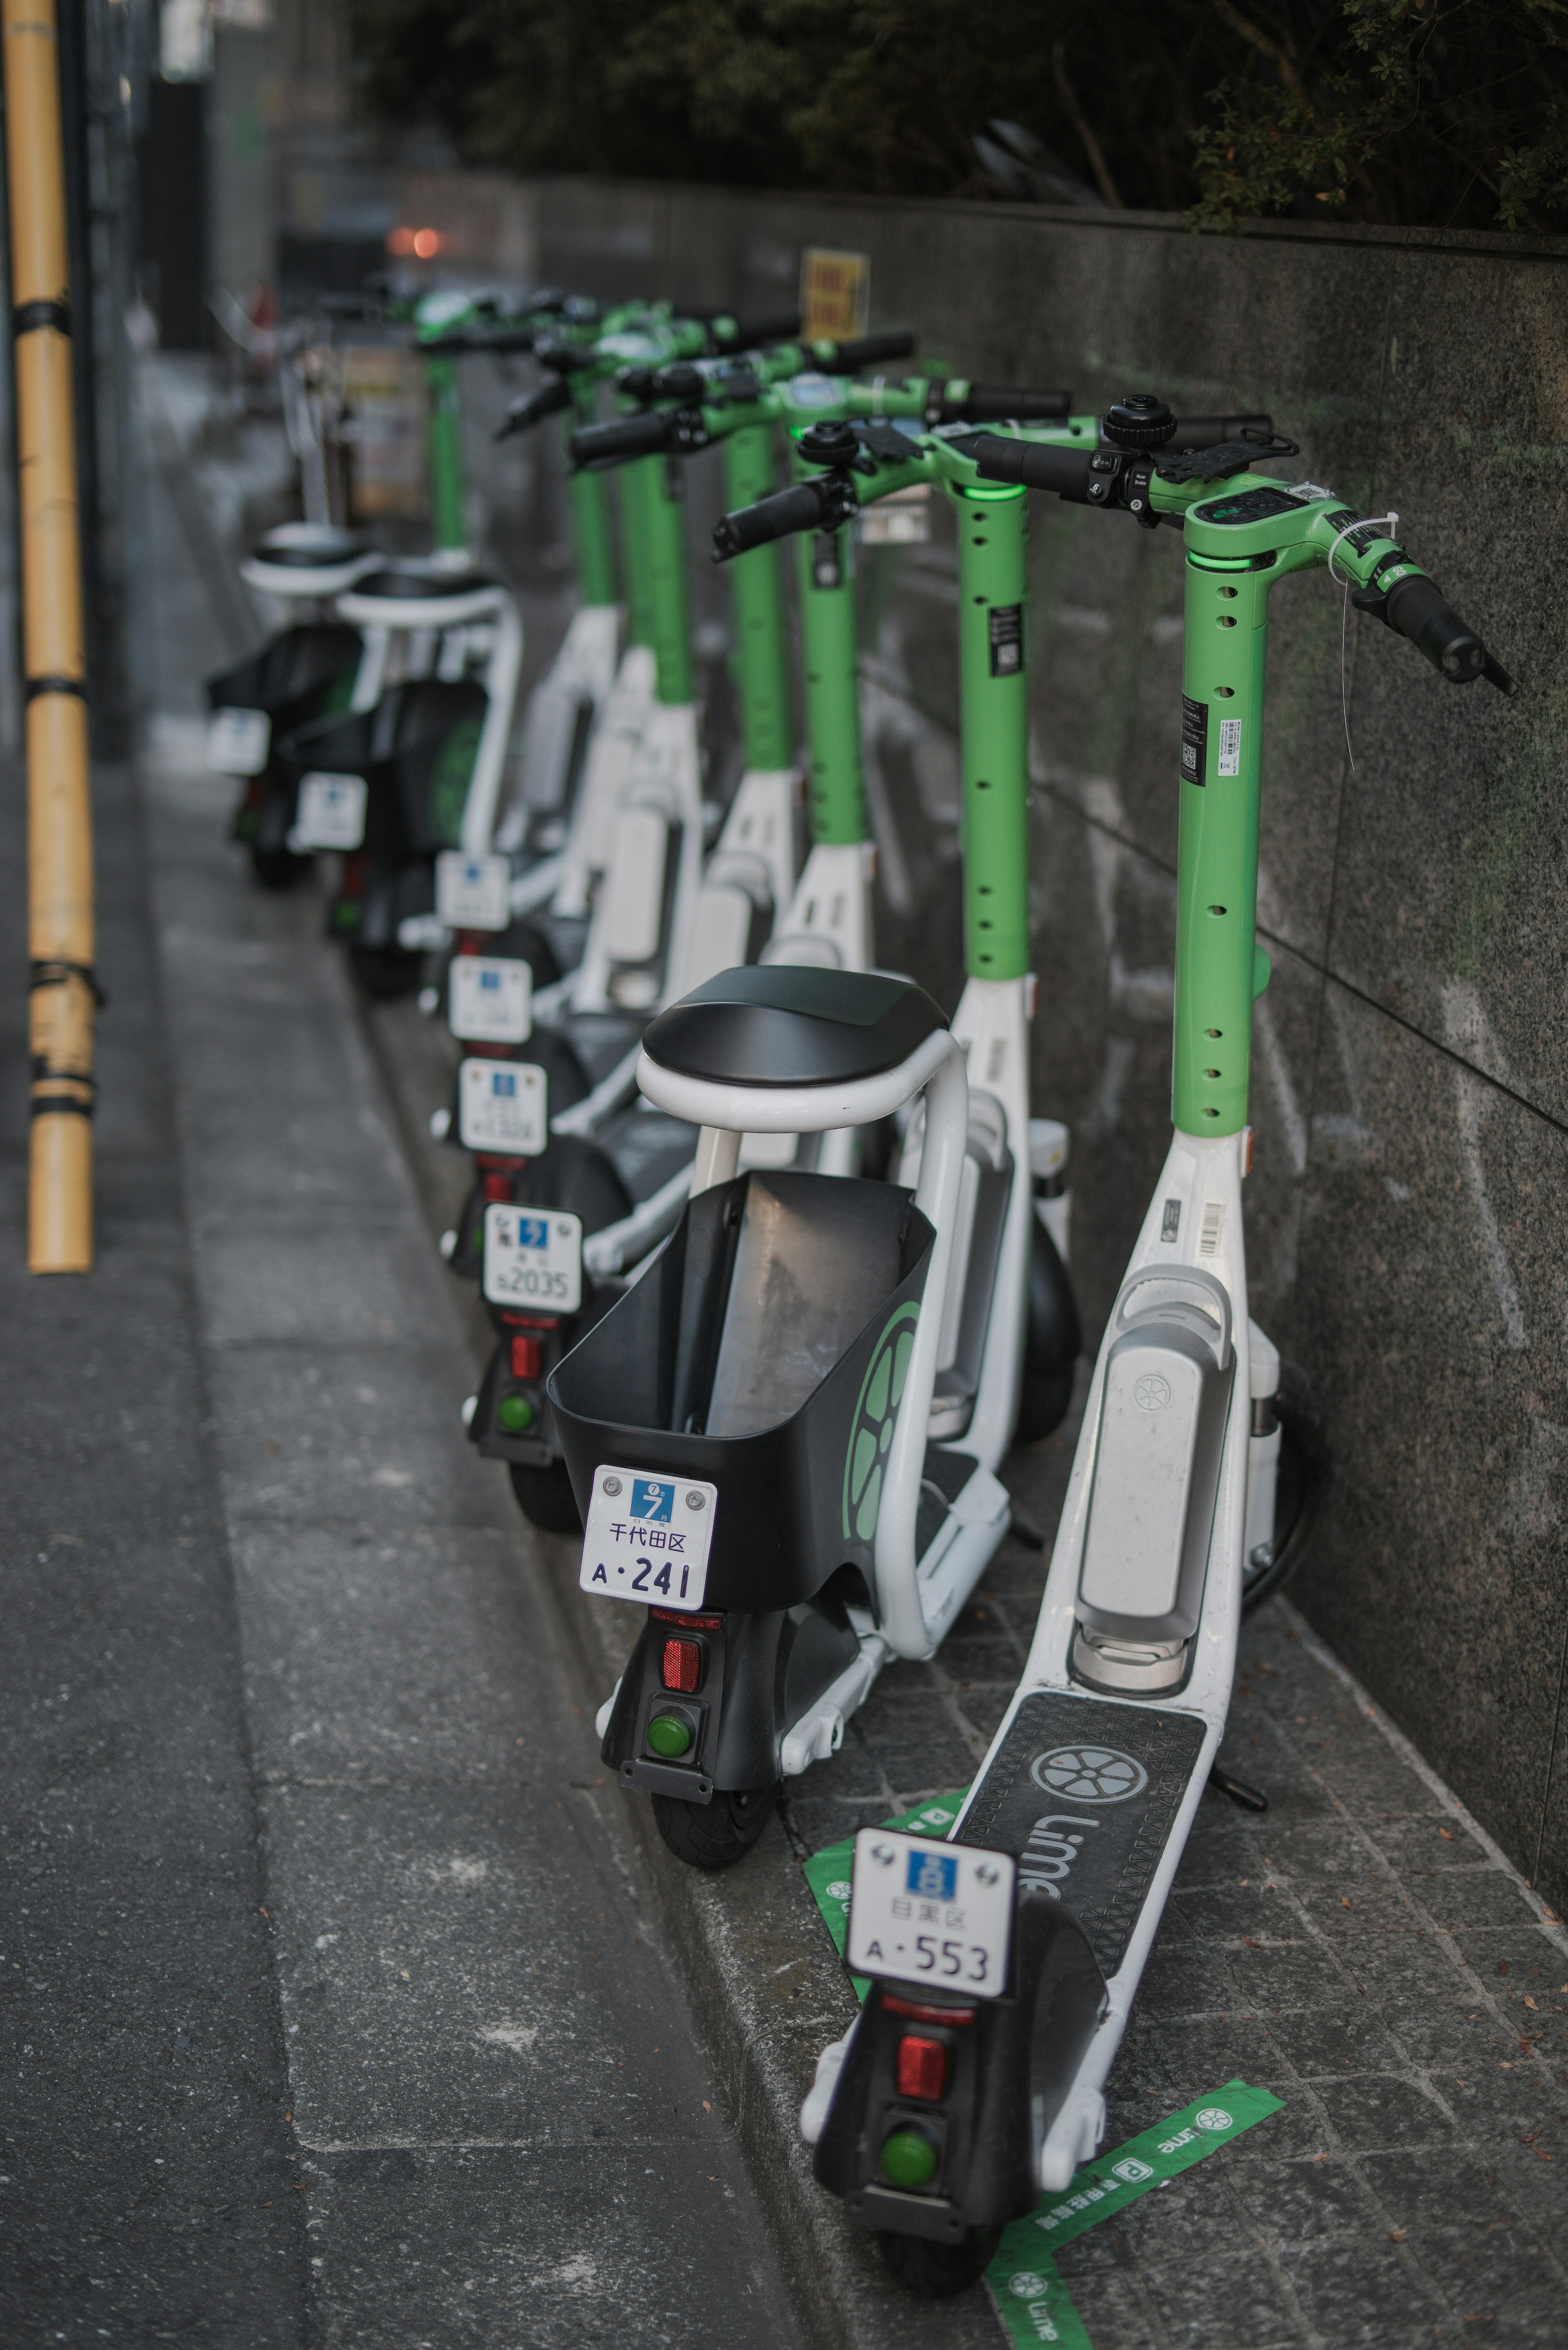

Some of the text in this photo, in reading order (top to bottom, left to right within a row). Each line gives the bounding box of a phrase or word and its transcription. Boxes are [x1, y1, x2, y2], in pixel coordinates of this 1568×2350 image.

[1392, 566, 1406, 576] GO
[609, 1523, 686, 1552] 千代田区
[1157, 2127, 1203, 2153] Lime
